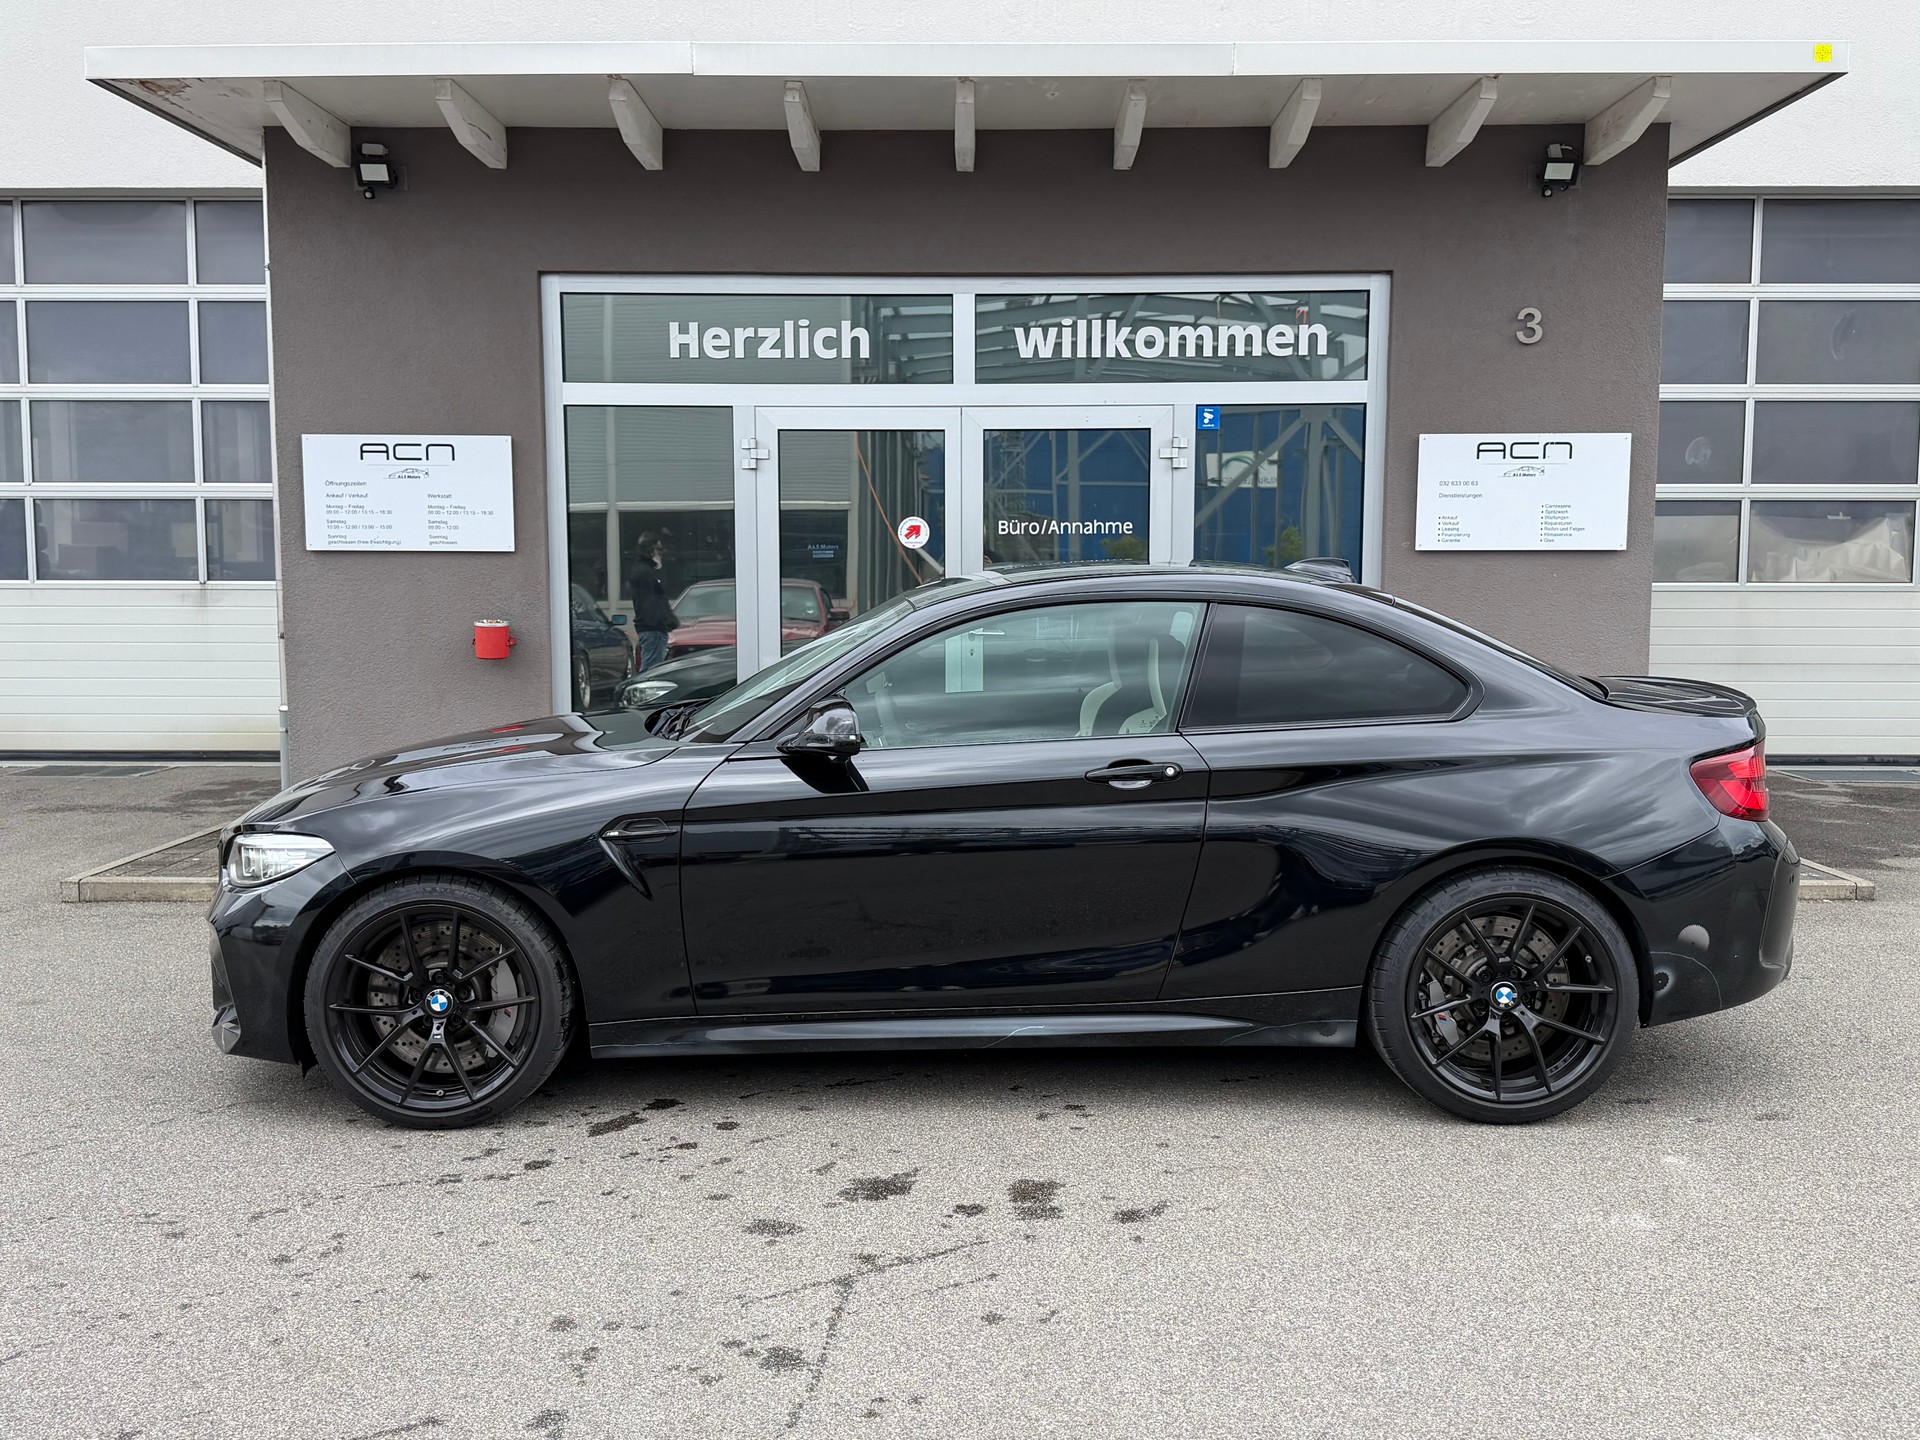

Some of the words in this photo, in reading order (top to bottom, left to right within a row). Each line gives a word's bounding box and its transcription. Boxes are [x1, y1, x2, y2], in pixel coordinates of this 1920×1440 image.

[669, 318, 870, 360] Herzlich
[1014, 318, 1329, 358] willkommen
[1515, 306, 1543, 344] 3
[997, 518, 1133, 535] Büro/Annahme
